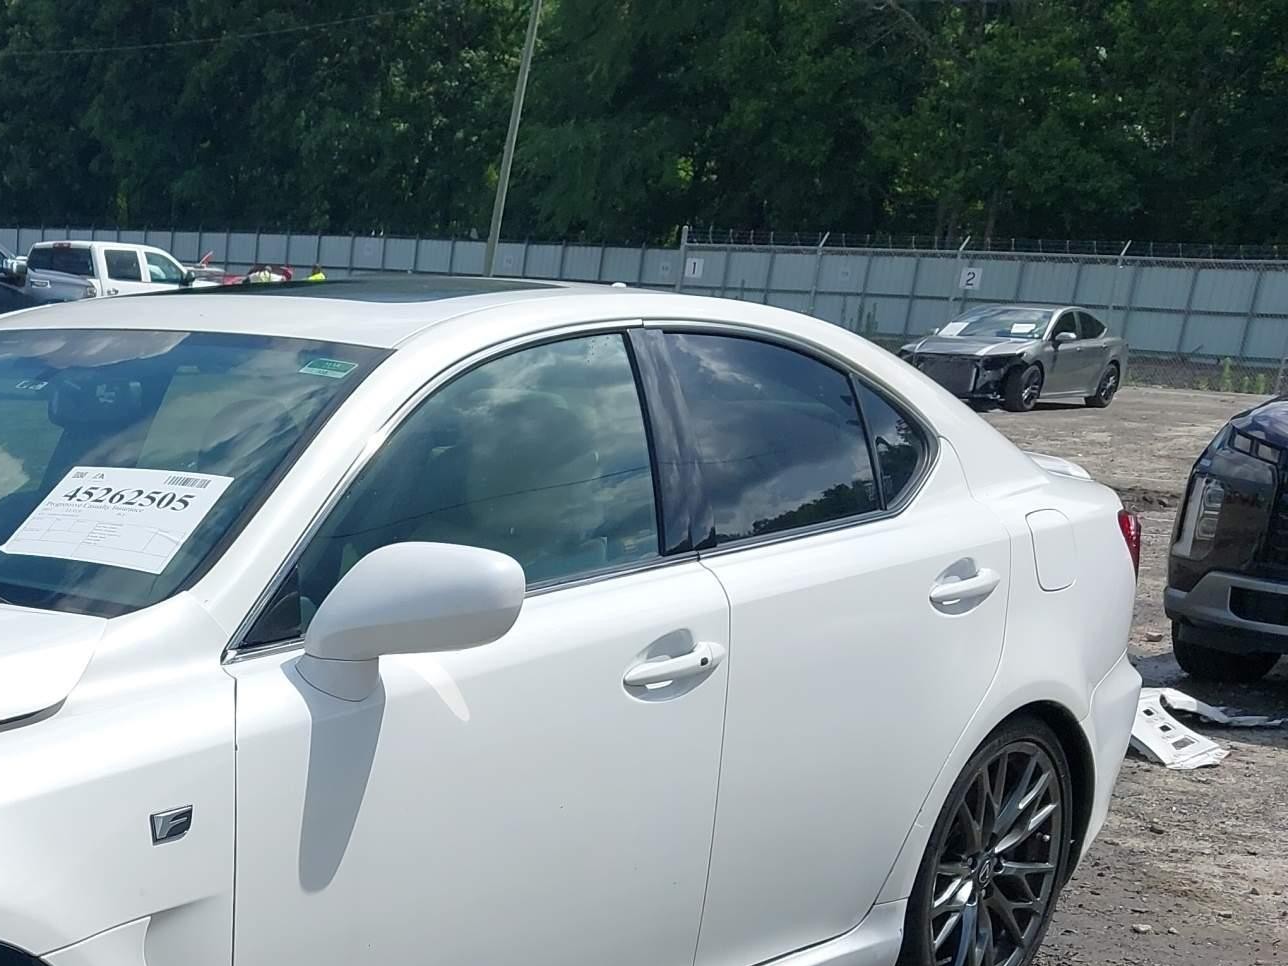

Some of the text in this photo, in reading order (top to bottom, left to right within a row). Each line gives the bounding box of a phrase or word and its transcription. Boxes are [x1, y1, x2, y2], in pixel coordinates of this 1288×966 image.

[692, 261, 697, 274] 1
[965, 271, 976, 286] 2
[64, 486, 196, 512] 45262505
